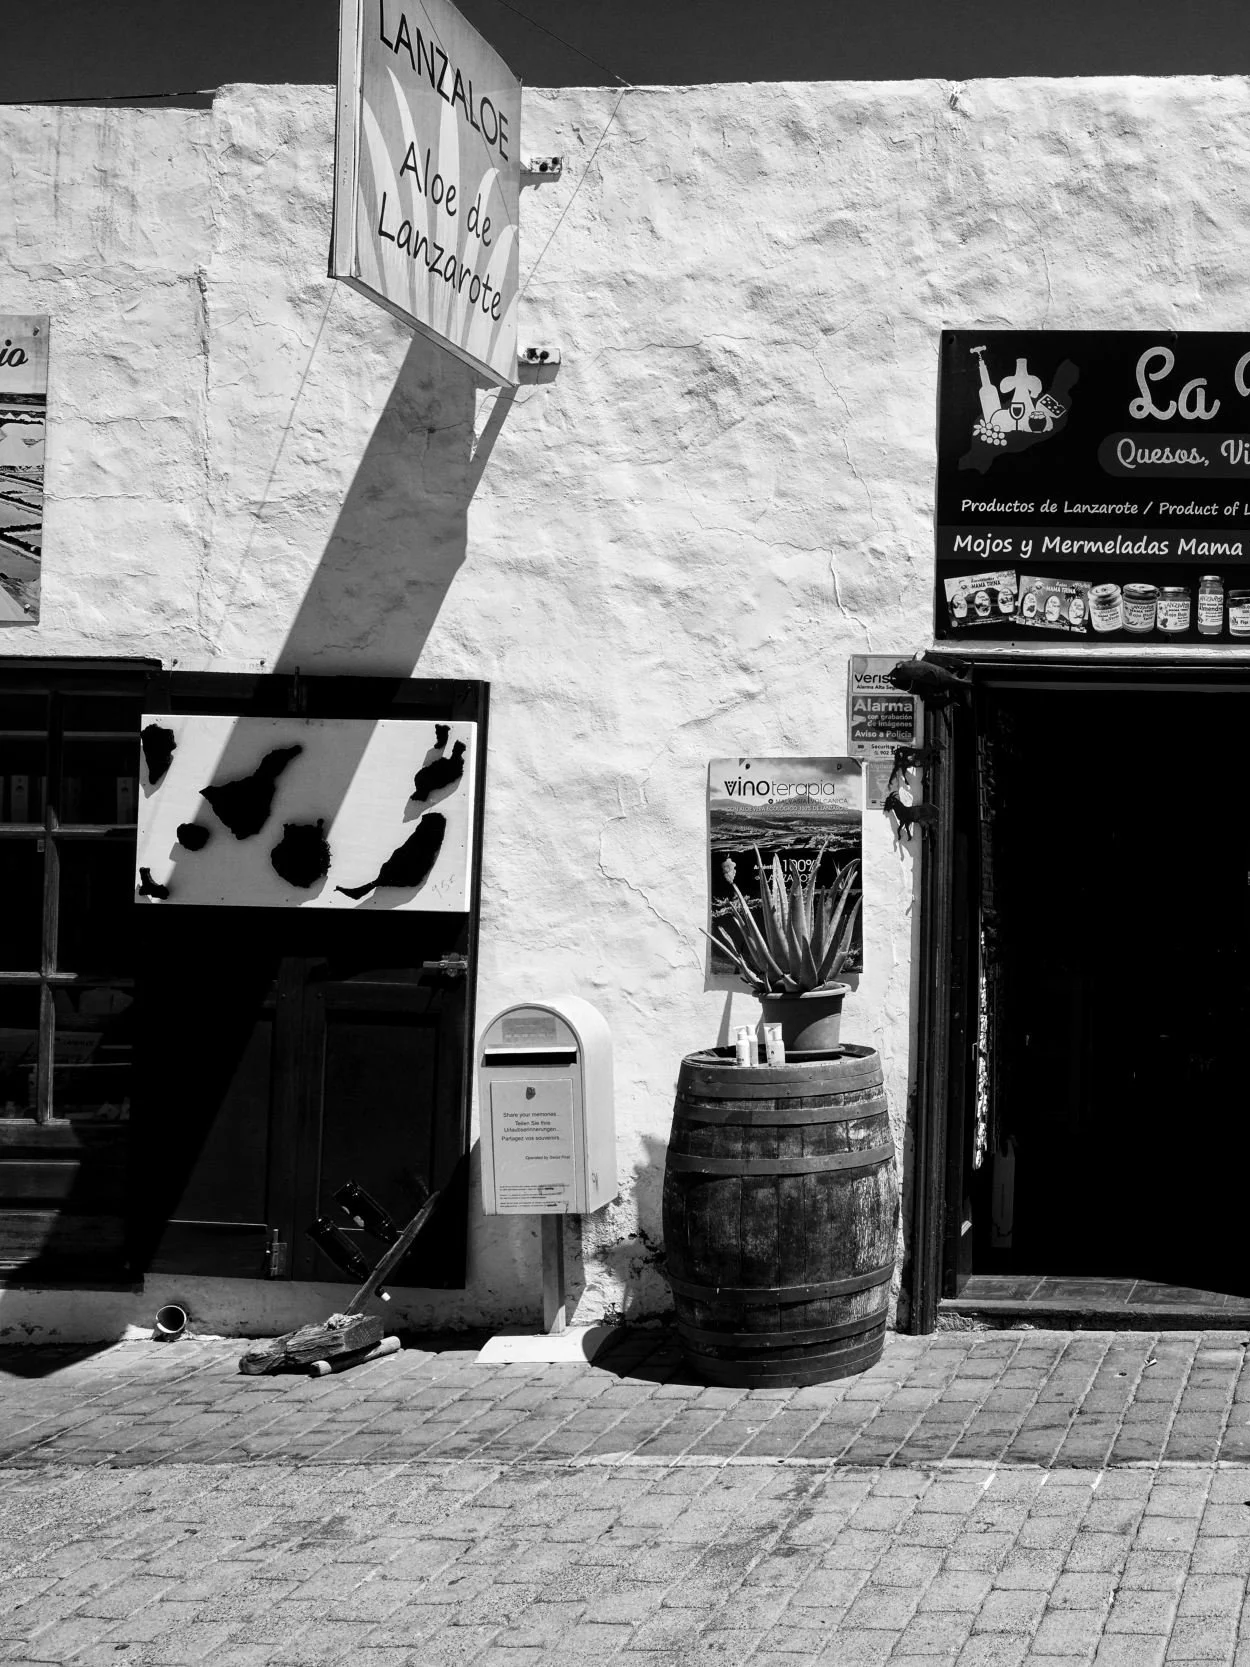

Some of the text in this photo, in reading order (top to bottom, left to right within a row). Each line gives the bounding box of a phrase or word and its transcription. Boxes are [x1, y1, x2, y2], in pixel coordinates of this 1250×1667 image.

[380, 0, 508, 162] LANZALOE
[400, 141, 492, 247] Aloe de
[378, 191, 501, 321] Lanzarote
[1129, 346, 1221, 421] La
[1116, 438, 1210, 469] Quesos,
[961, 498, 1035, 514] Productos
[1040, 499, 1058, 513] de
[1063, 500, 1138, 515] Lanzarote
[1143, 501, 1154, 515] /
[1159, 500, 1219, 516] Product
[1223, 501, 1240, 516] of
[953, 532, 1013, 558] Mojos
[1020, 539, 1033, 558] y
[1041, 534, 1169, 556] Mermeladas
[1177, 538, 1243, 556] Mama
[855, 674, 891, 684] veris
[854, 698, 913, 712] Alarma
[855, 730, 877, 738] Aviso
[724, 776, 835, 804] vinoterapia
